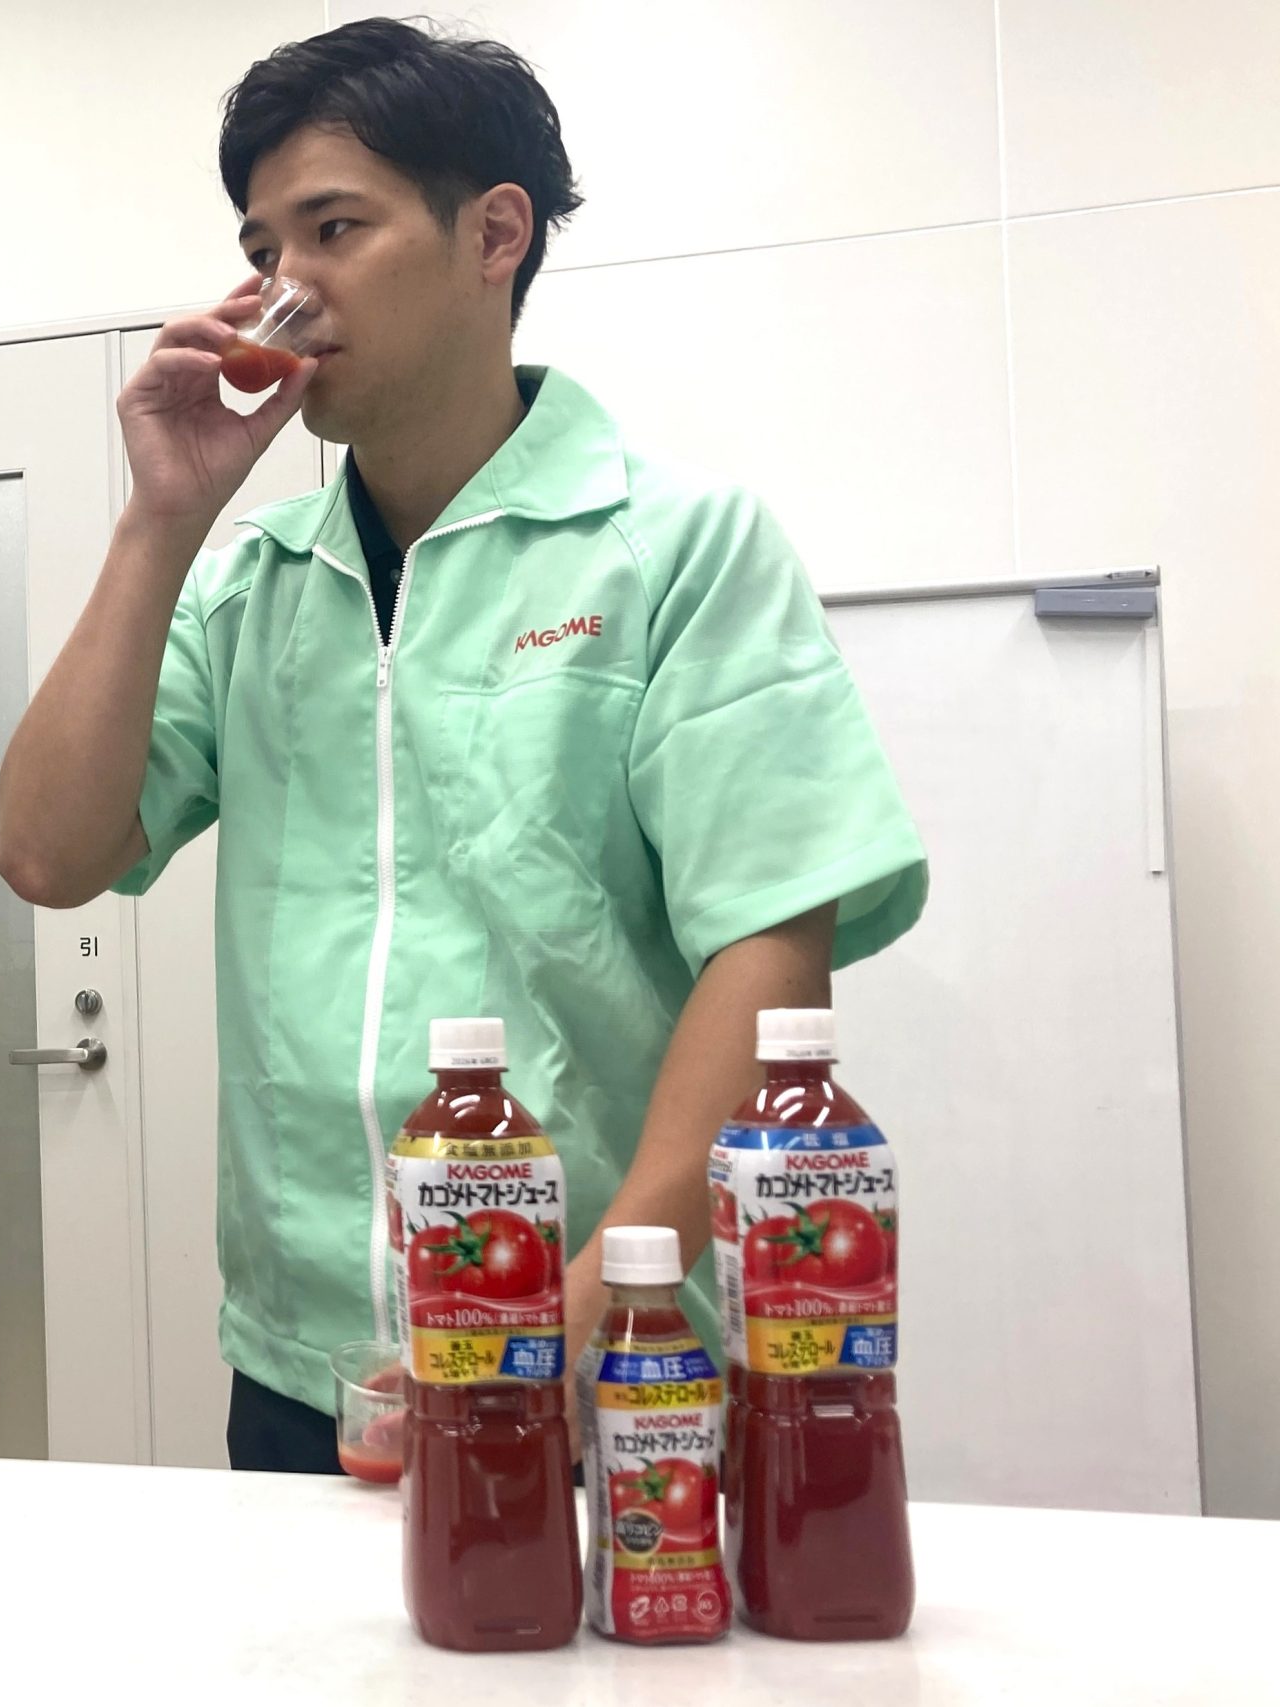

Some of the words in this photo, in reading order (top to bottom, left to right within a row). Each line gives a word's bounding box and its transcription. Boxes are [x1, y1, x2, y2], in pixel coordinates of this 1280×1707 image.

[514, 615, 603, 654] KAGOME
[80, 936, 99, 957] 引
[785, 1152, 869, 1171] KAGOME
[447, 1163, 532, 1181] KAGOME
[754, 1168, 895, 1198] カゴメトマトジュース
[418, 1180, 559, 1207] カゴメトマトジュース
[853, 1336, 893, 1355] 血圧
[512, 1347, 557, 1367] 血圧
[640, 1355, 687, 1380] 血圧
[634, 1413, 703, 1430] KAGOME
